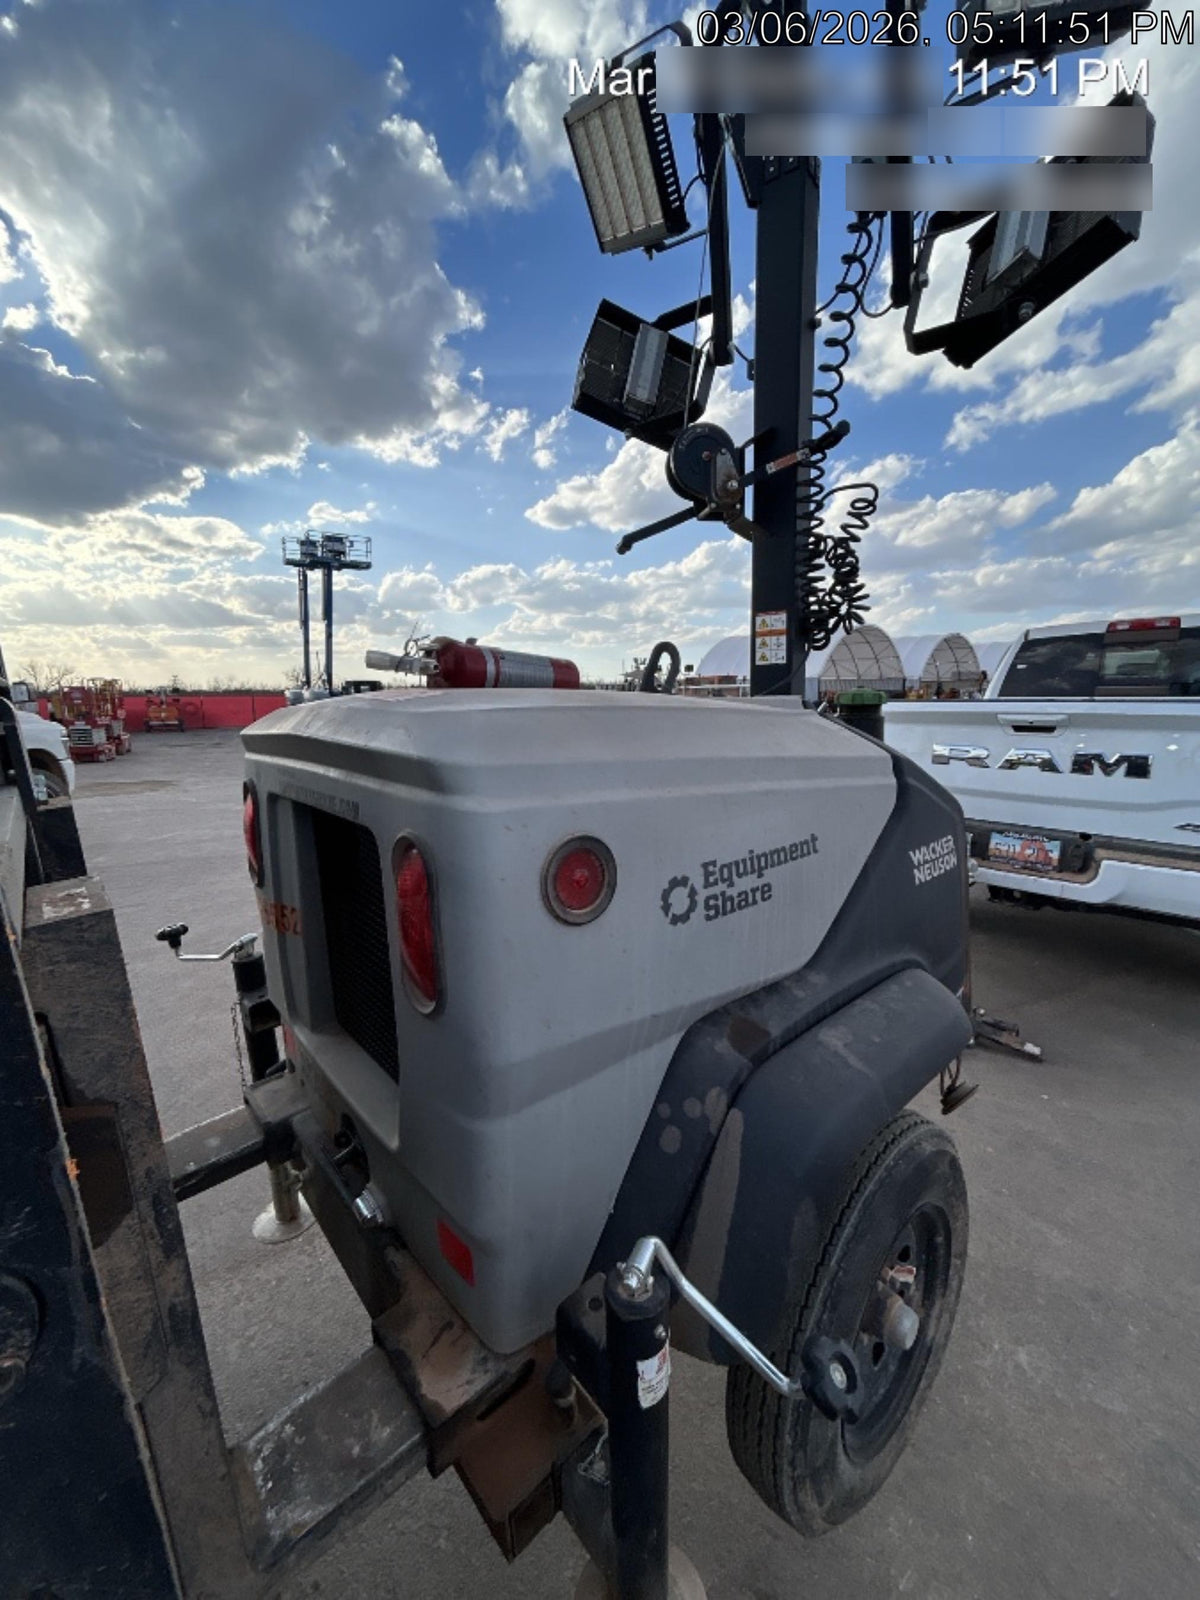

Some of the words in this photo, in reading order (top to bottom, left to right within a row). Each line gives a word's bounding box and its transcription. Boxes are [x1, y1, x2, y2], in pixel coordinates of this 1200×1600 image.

[932, 744, 1153, 779] RAM
[701, 833, 819, 889] Equipment
[908, 834, 956, 867] WACKER
[913, 850, 958, 886] NEUSON
[703, 881, 773, 922] Share
